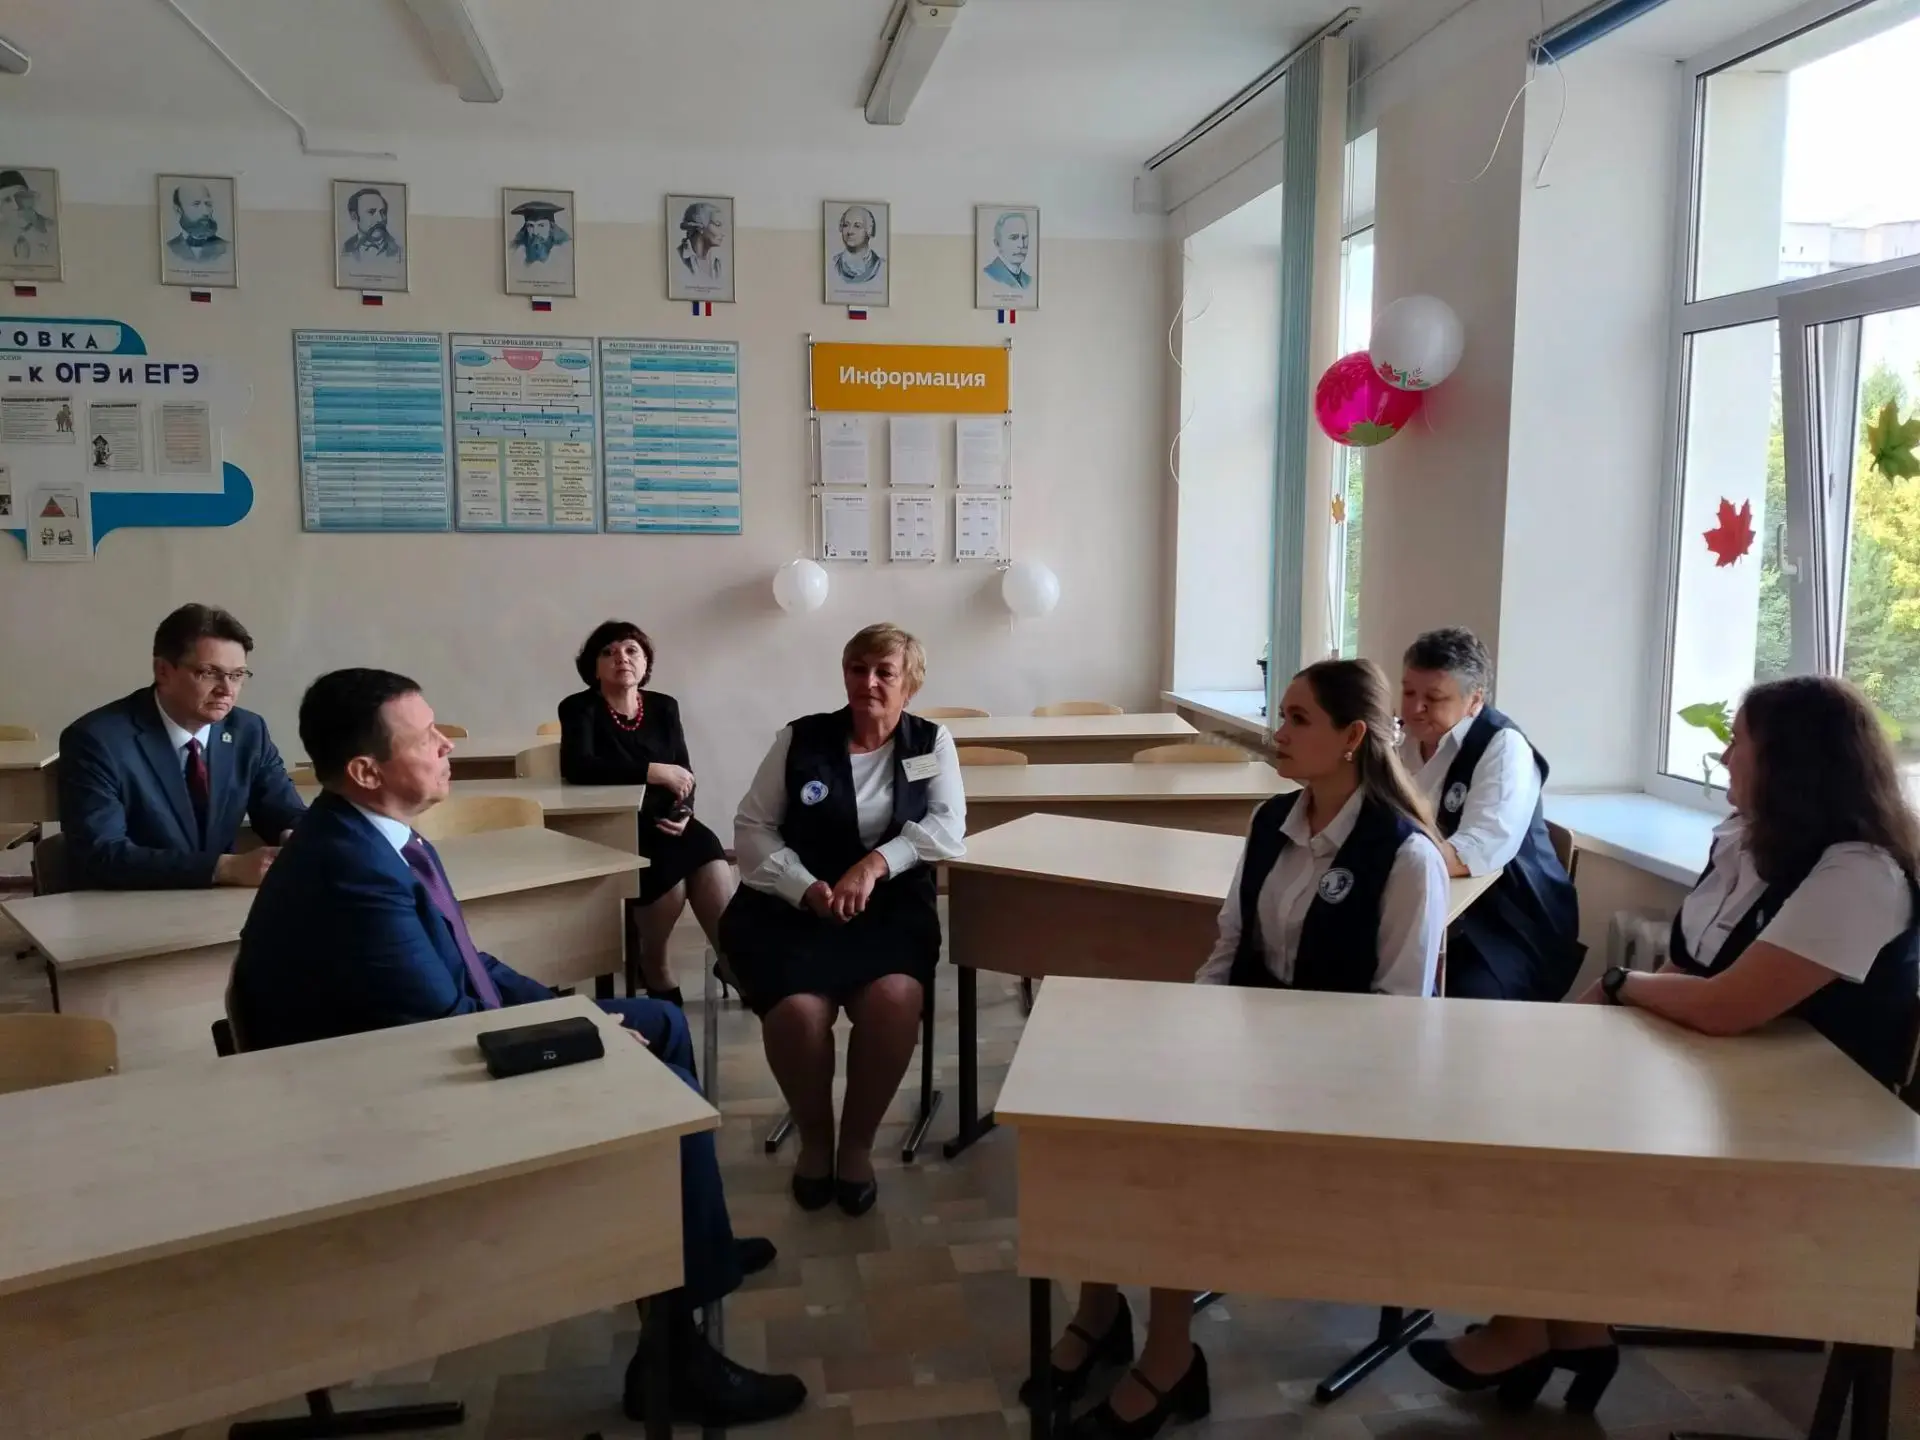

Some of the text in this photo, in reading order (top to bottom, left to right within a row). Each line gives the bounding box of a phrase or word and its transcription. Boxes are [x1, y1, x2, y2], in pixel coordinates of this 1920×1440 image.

[0, 330, 98, 350] ОВКА
[56, 362, 110, 384] ОГЭ
[145, 363, 200, 385] ЕГЭ
[839, 365, 986, 391] Информация
